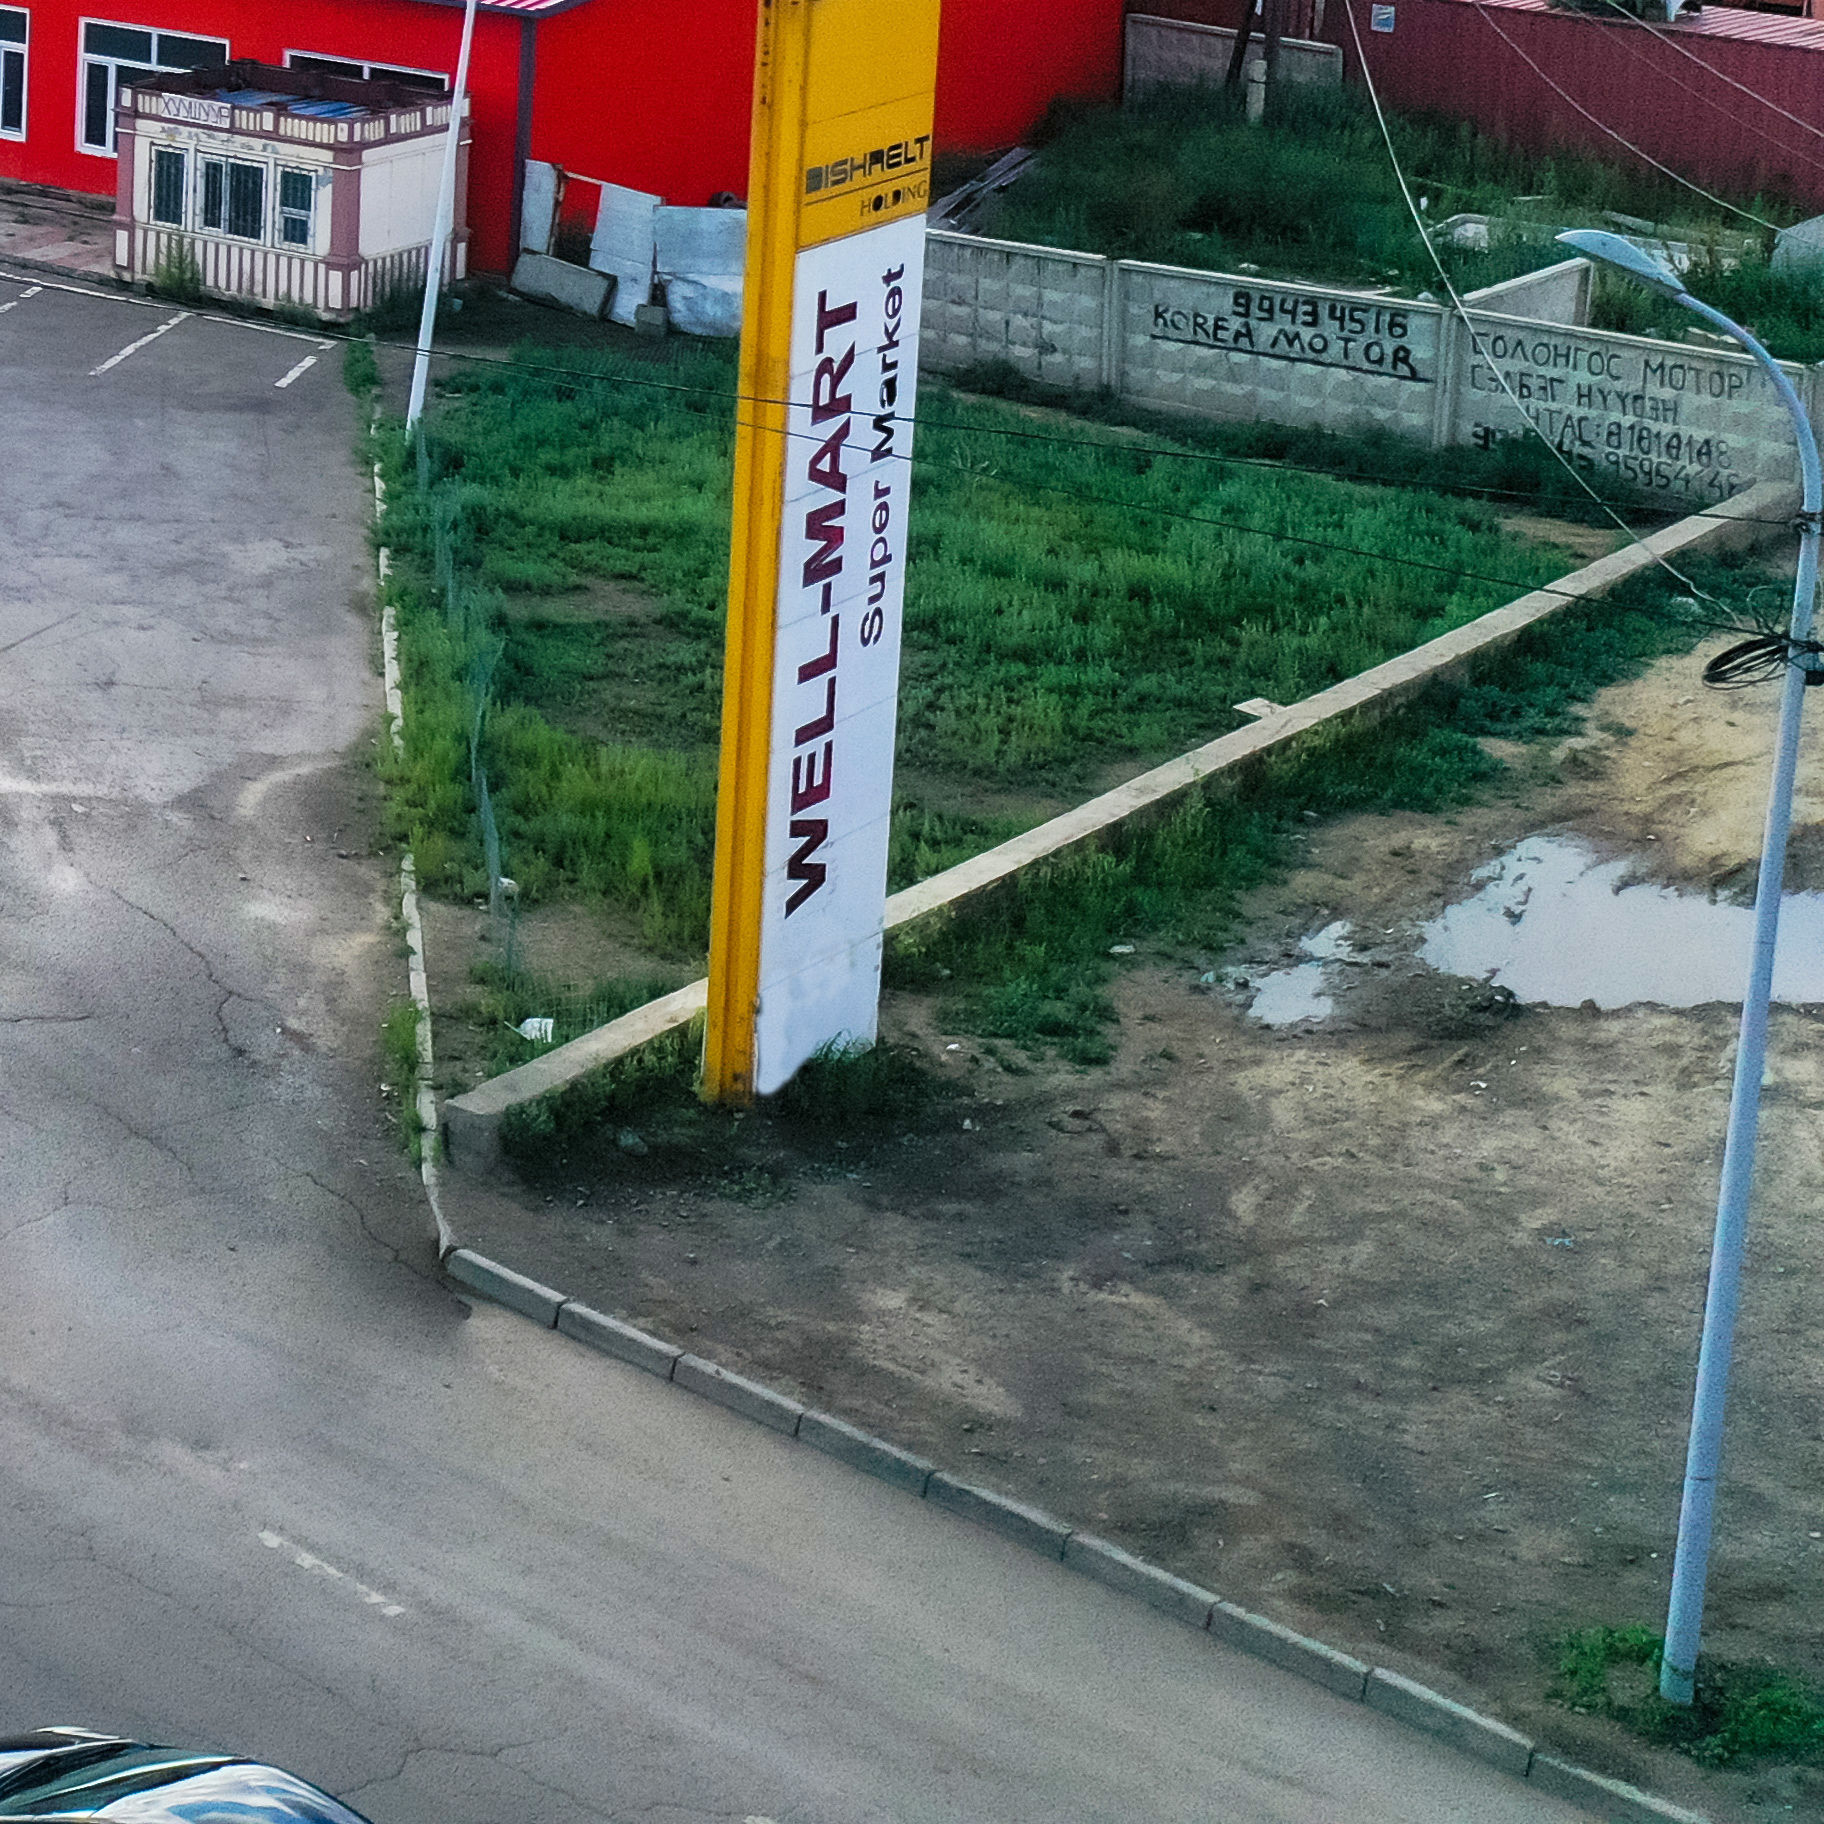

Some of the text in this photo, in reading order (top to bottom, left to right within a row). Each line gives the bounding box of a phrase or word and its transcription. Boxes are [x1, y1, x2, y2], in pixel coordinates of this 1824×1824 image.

[859, 179, 928, 216] HOLDING
[1154, 303, 1418, 377] KOREA MOTOR
[1471, 331, 1744, 400] СОЛОНГОС МОТОР
[859, 262, 905, 647] Super Market
[784, 289, 858, 919] WELL-MART
